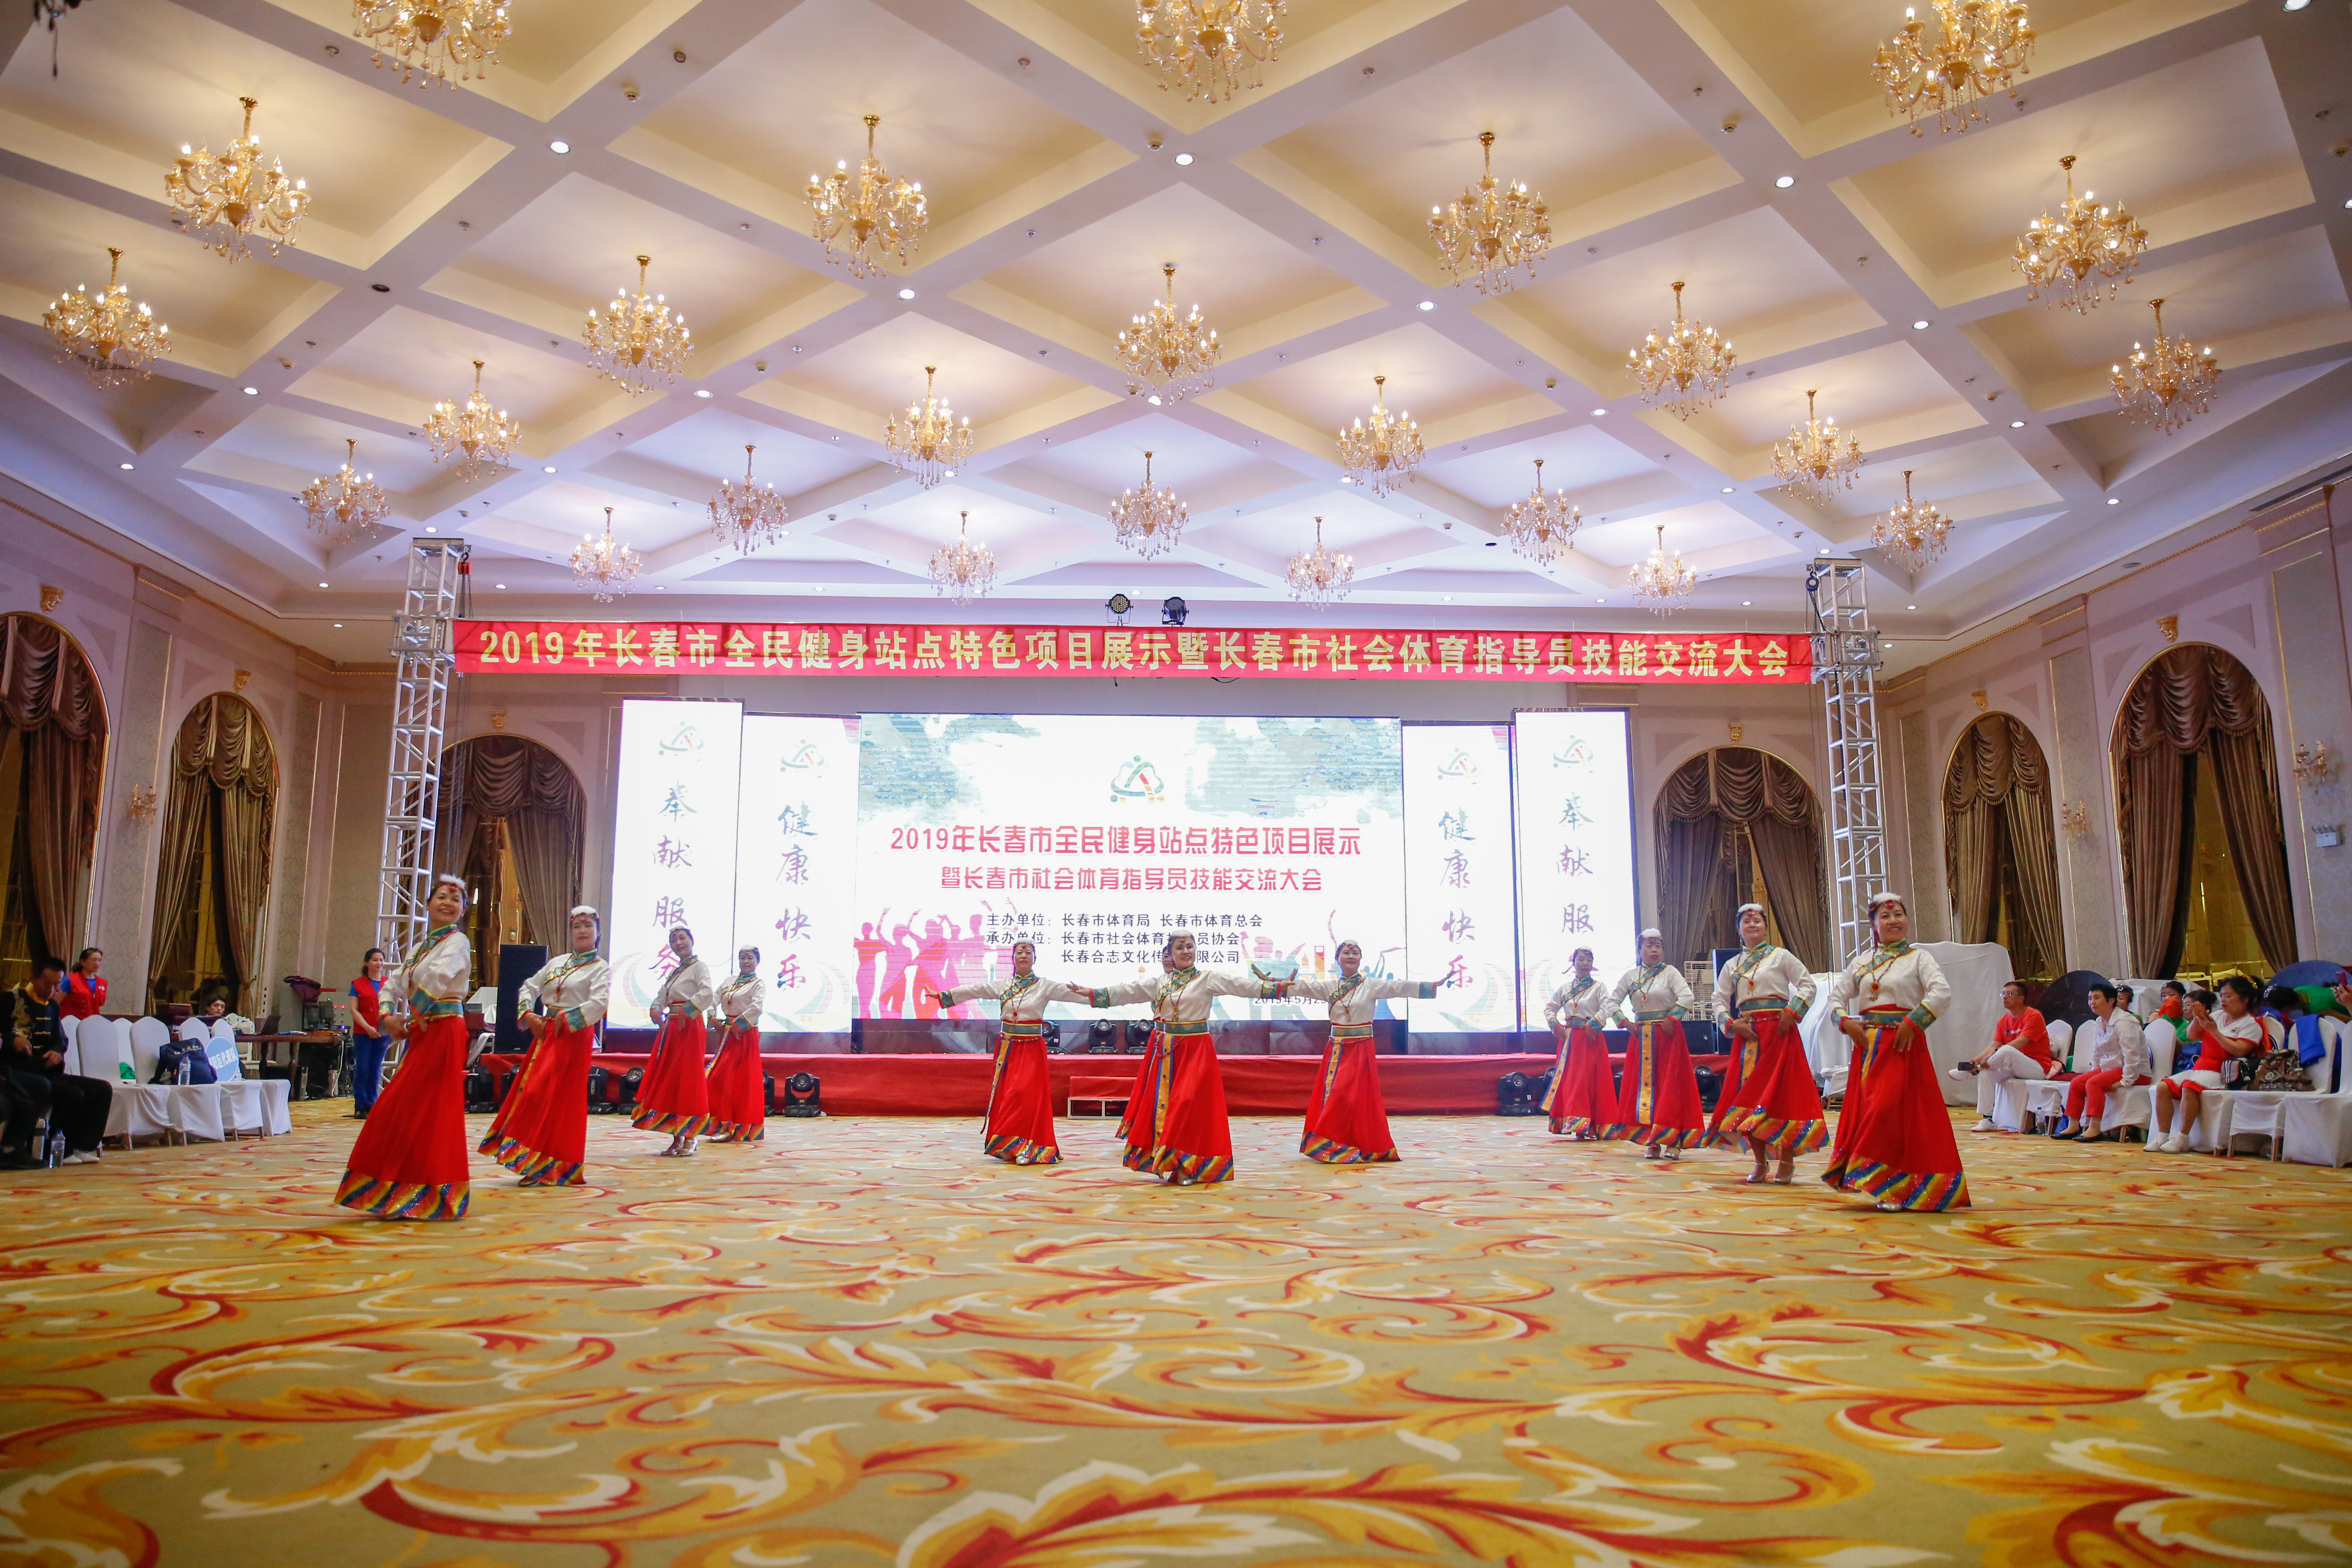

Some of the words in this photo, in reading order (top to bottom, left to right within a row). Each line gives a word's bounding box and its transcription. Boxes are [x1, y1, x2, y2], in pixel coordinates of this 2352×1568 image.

[481, 628, 1788, 677] 2019年长春市全民健身站点特色项目展示暨长春市社会体育指导员技能交流大会
[891, 825, 1361, 855] 2019年长春市全民健身站点特色项目展示
[942, 866, 1321, 891] 暨长春市社会体育指导员技能交流大会
[1557, 792, 1599, 973] 奉献服
[1062, 913, 1149, 927] 长春市体育局
[1160, 914, 1262, 927] 长春市体育总会
[1062, 931, 1239, 945] 长春市社会体育员协会
[1061, 949, 1239, 964] 长春合志文化传限公司
